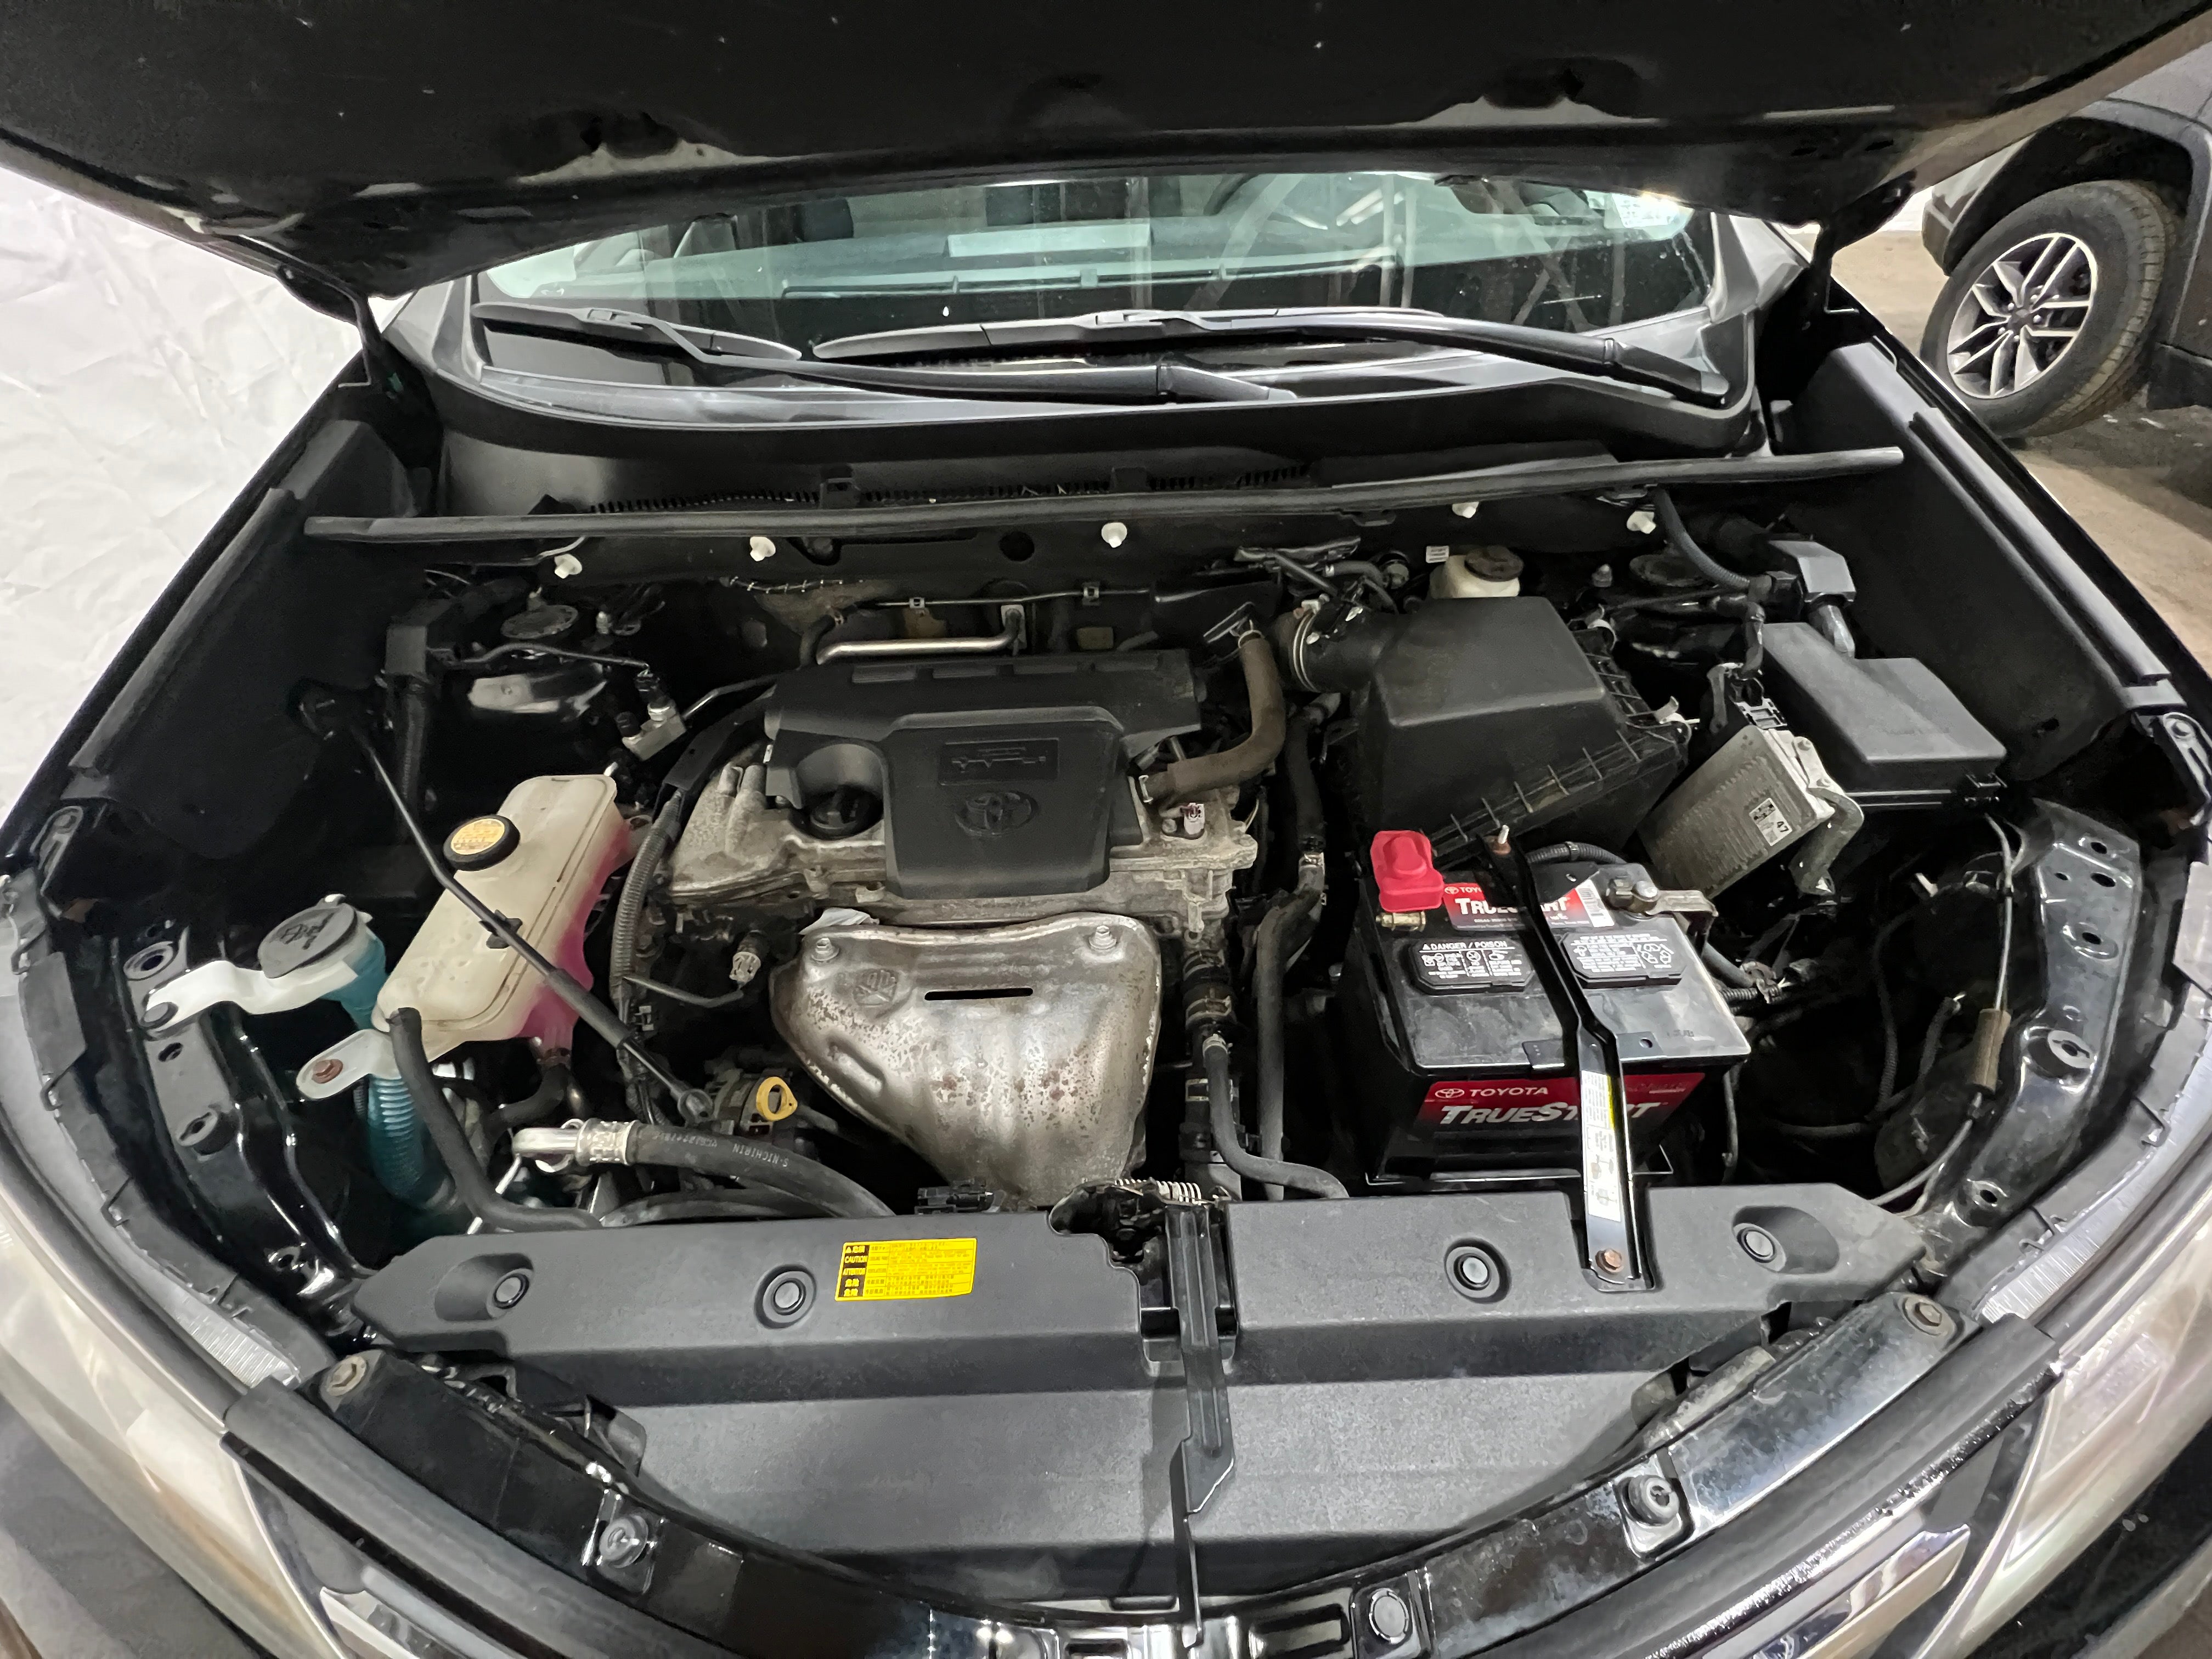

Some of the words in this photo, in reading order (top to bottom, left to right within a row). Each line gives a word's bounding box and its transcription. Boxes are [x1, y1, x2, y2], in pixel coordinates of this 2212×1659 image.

[1430, 942, 1467, 950] DANGER
[1470, 1087, 1549, 1097] TOYOTA
[845, 1255, 868, 1263] CAUTION
